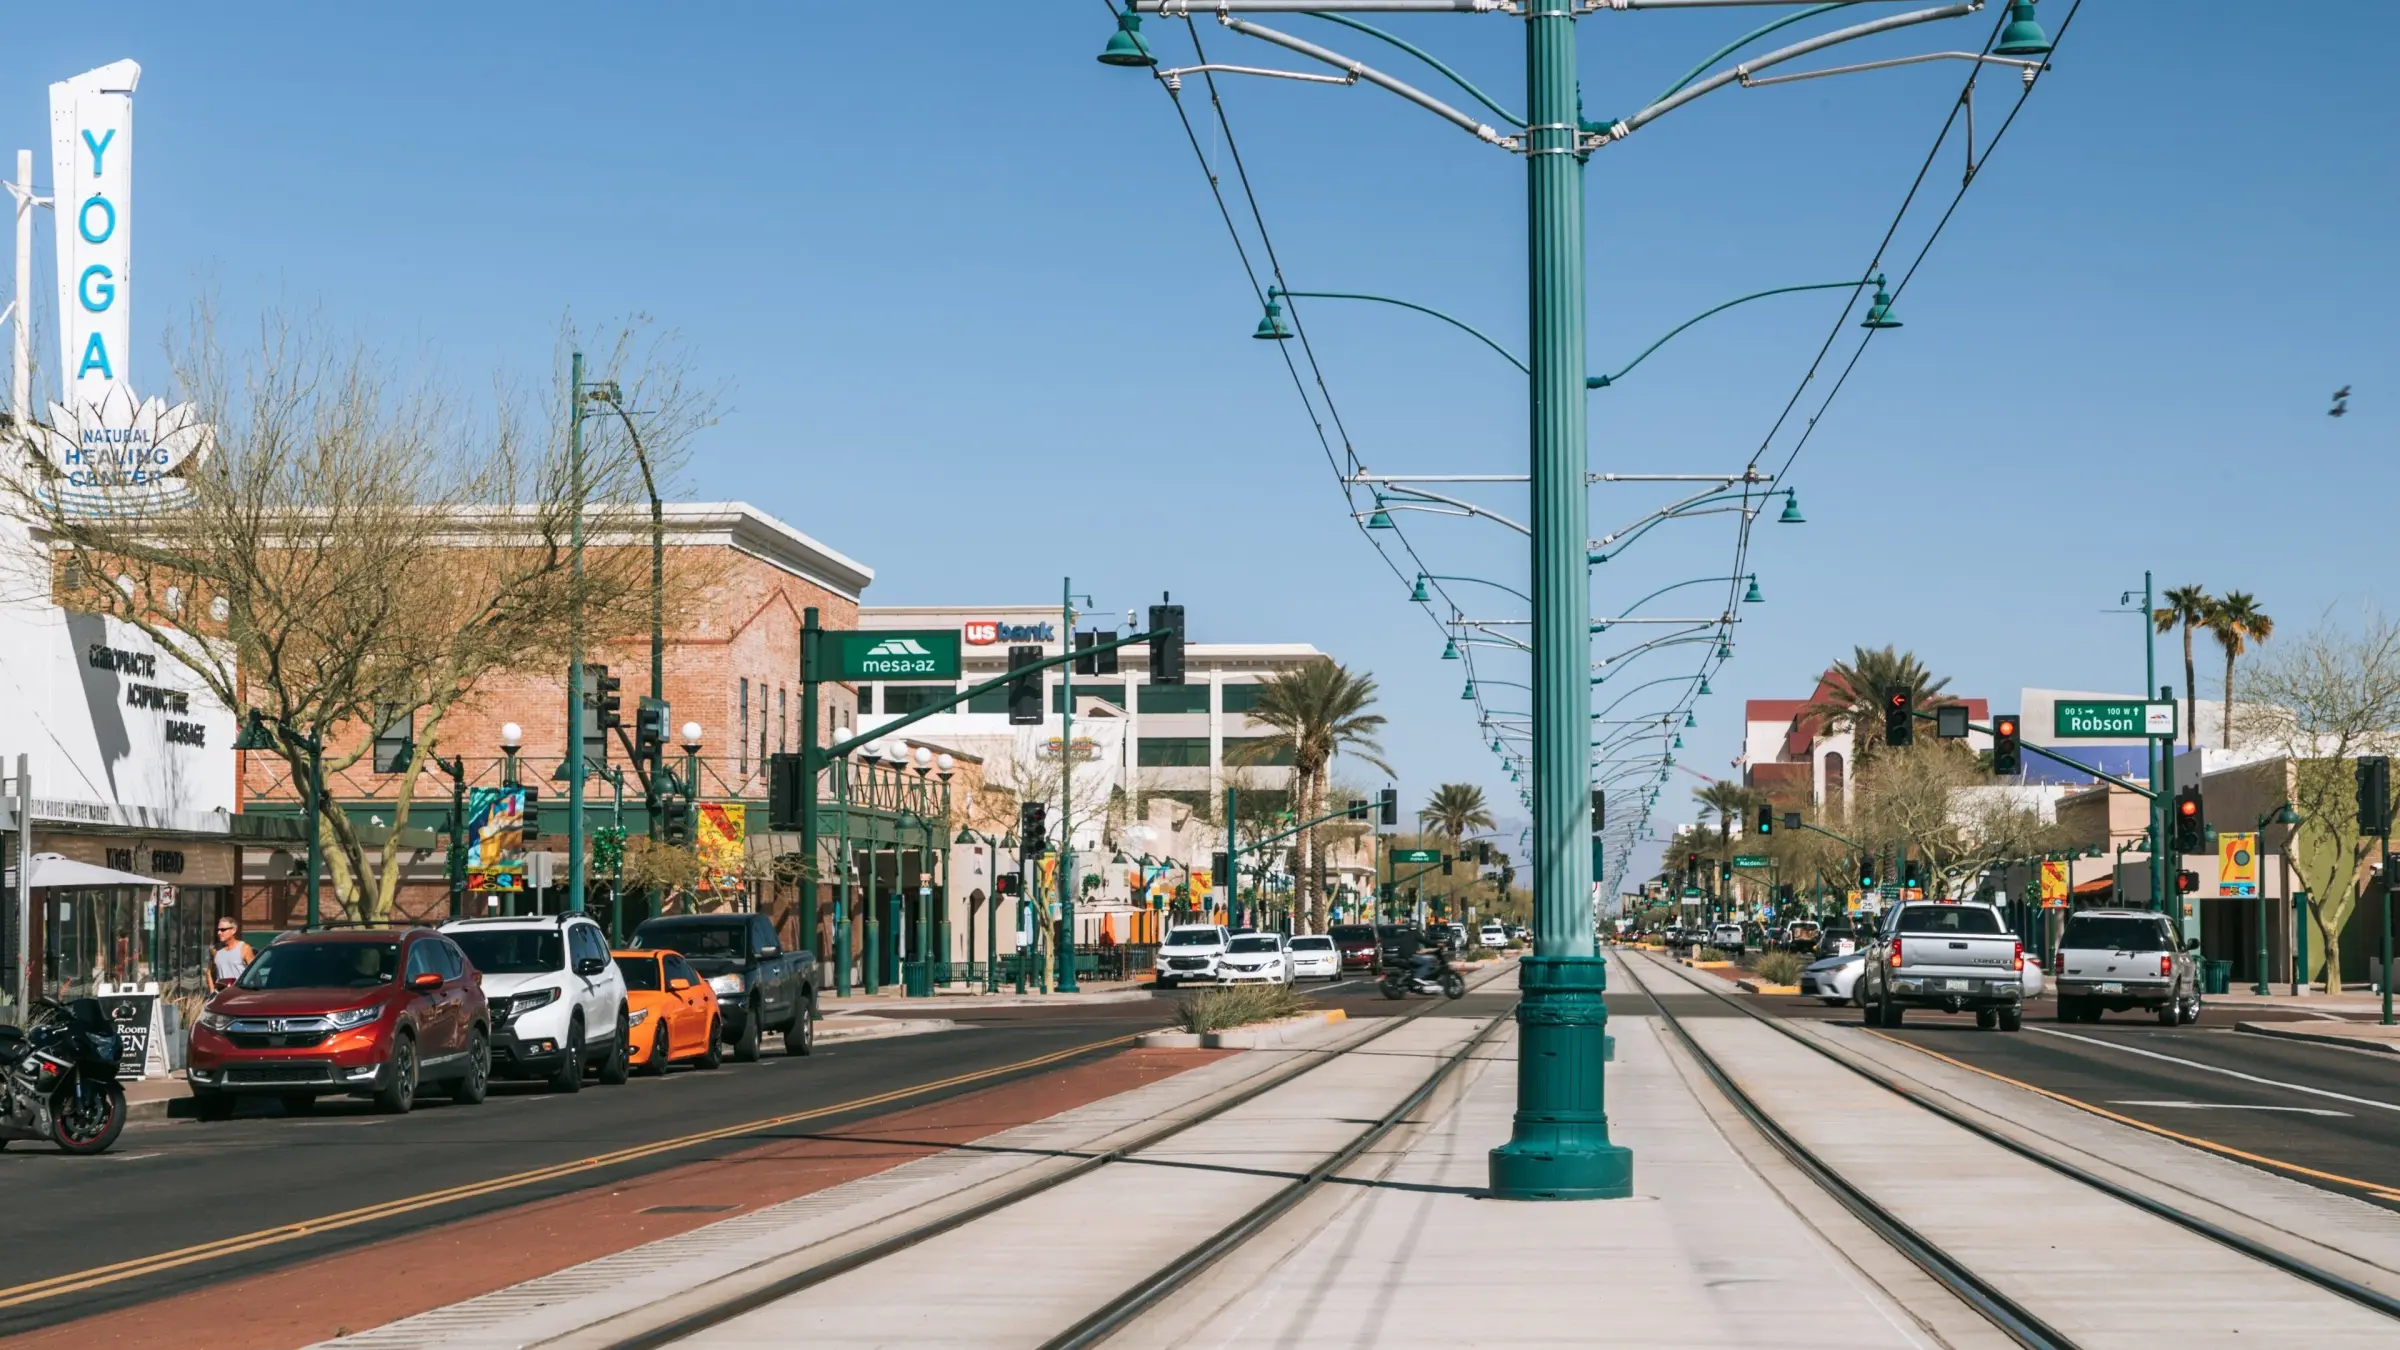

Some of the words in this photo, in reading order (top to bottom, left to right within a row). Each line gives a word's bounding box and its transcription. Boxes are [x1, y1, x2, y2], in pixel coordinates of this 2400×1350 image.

[77, 129, 117, 380] YOGA
[83, 428, 151, 444] NATURAL
[65, 448, 169, 466] HEALING
[69, 470, 163, 488] CENTER
[89, 643, 156, 680] CHIROPRACTIC
[126, 682, 189, 717] ACUPUNCTURE
[2107, 707, 2121, 716] 100
[2123, 707, 2131, 716] W
[2071, 716, 2133, 731] Robson
[165, 719, 206, 749] MASSAGE
[46, 800, 64, 817] HOUSE
[65, 802, 88, 820] VINTAGE
[88, 804, 109, 821] MARKET
[1862, 902, 1874, 910] 25
[117, 1024, 148, 1034] Room
[120, 1035, 147, 1052] EN
